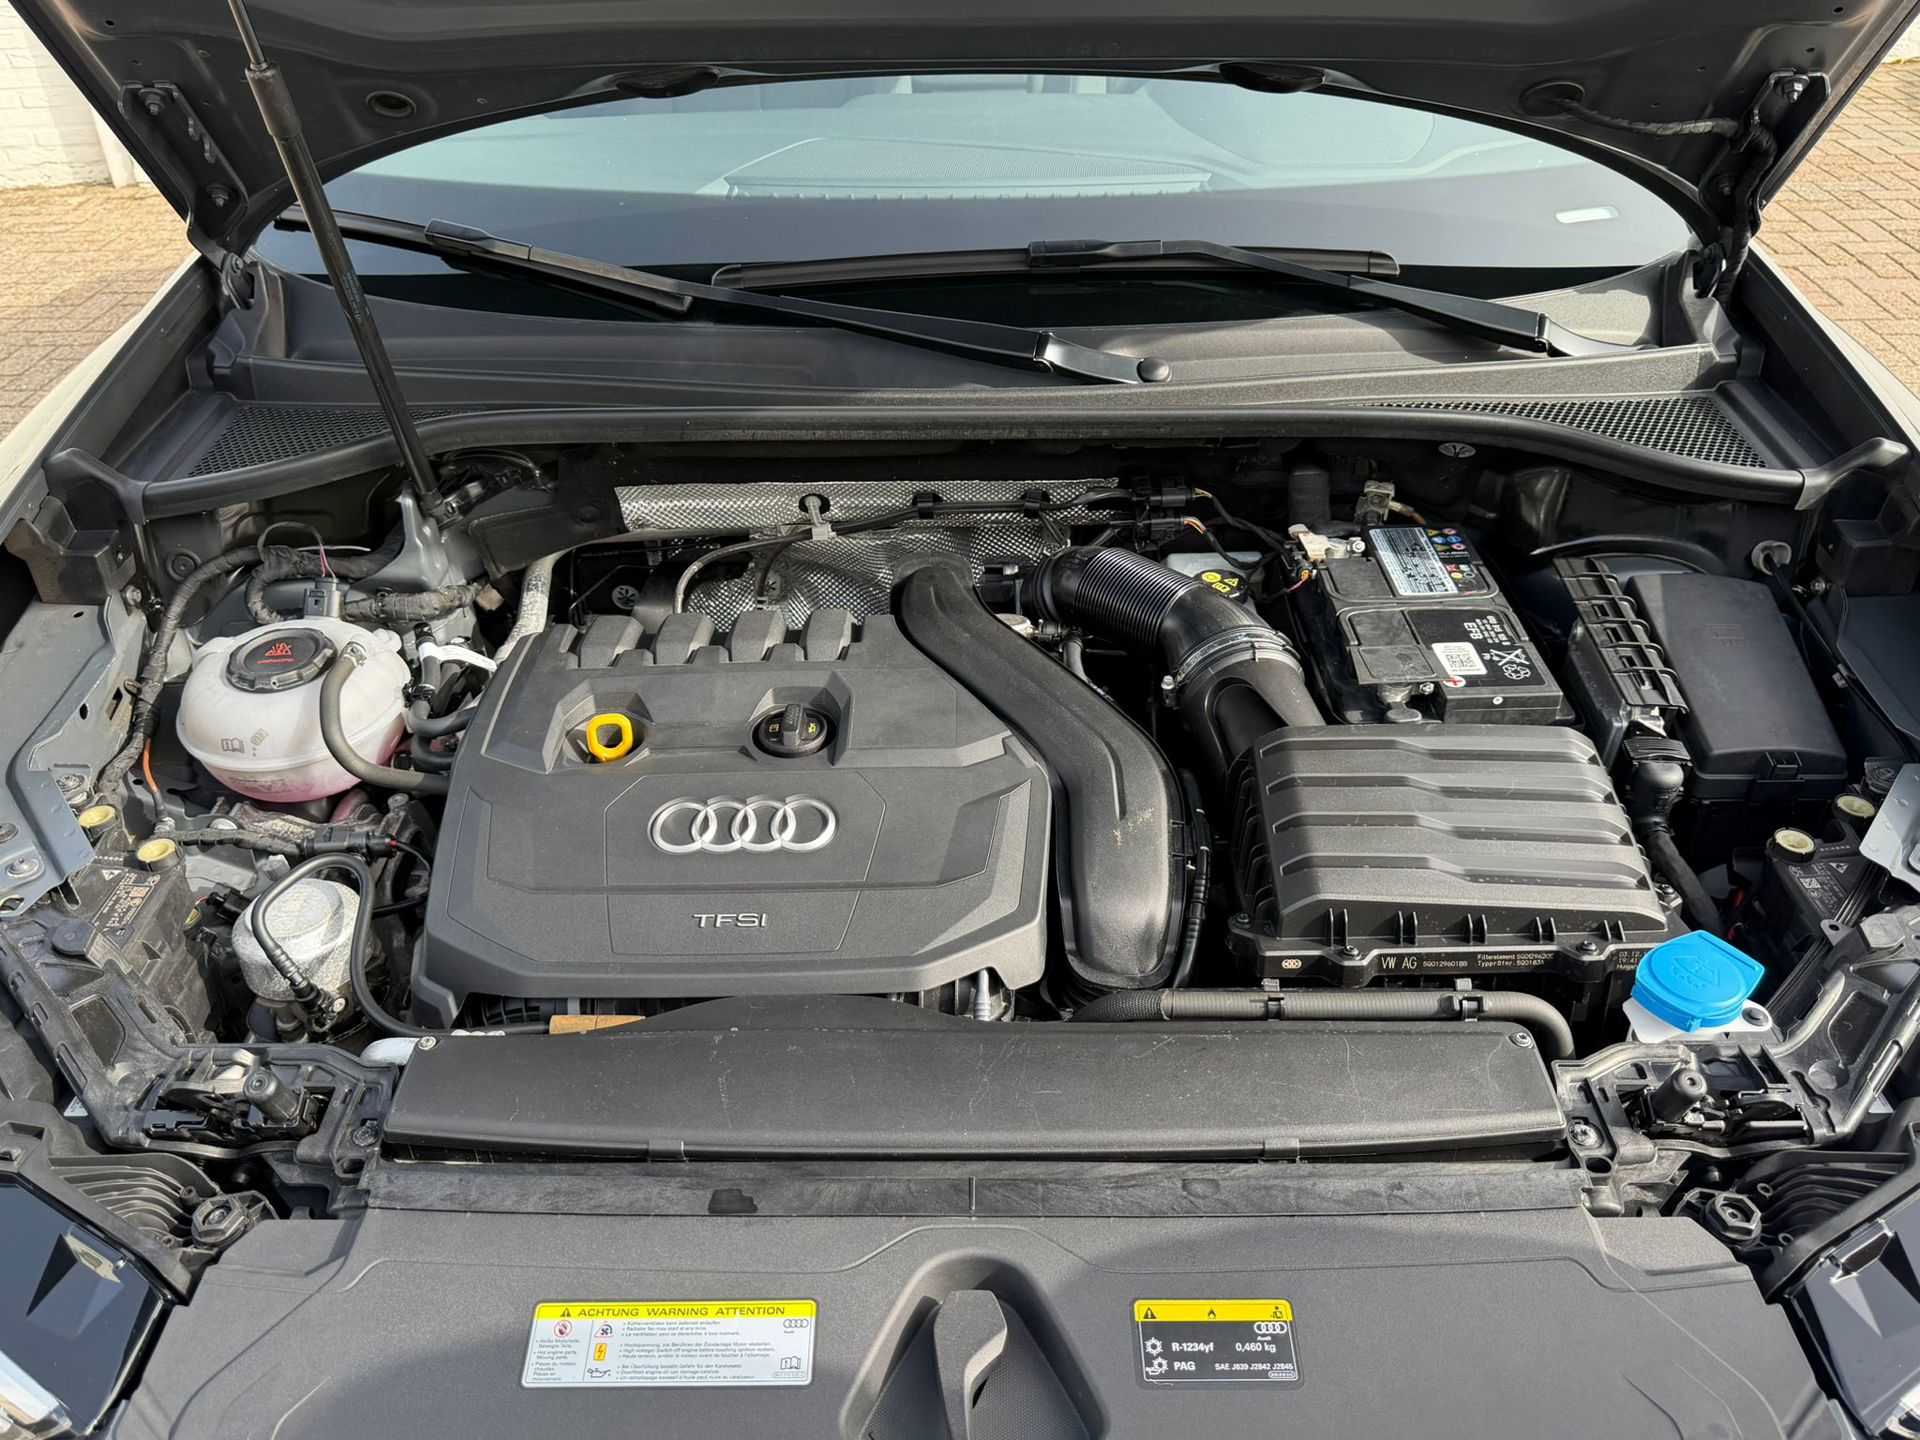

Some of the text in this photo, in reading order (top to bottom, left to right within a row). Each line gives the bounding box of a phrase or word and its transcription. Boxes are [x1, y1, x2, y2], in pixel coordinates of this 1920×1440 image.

[1463, 622, 1484, 640] EFB
[693, 913, 767, 928] TFSI
[1381, 956, 1396, 969] VW
[1401, 956, 1418, 969] AG
[578, 1306, 786, 1317] ACHTUNG WARNING ATTENTION
[1171, 1342, 1277, 1354] R-1234yf 0,460 kg
[1173, 1361, 1196, 1371] PAG
[1214, 1363, 1231, 1371] SAE
